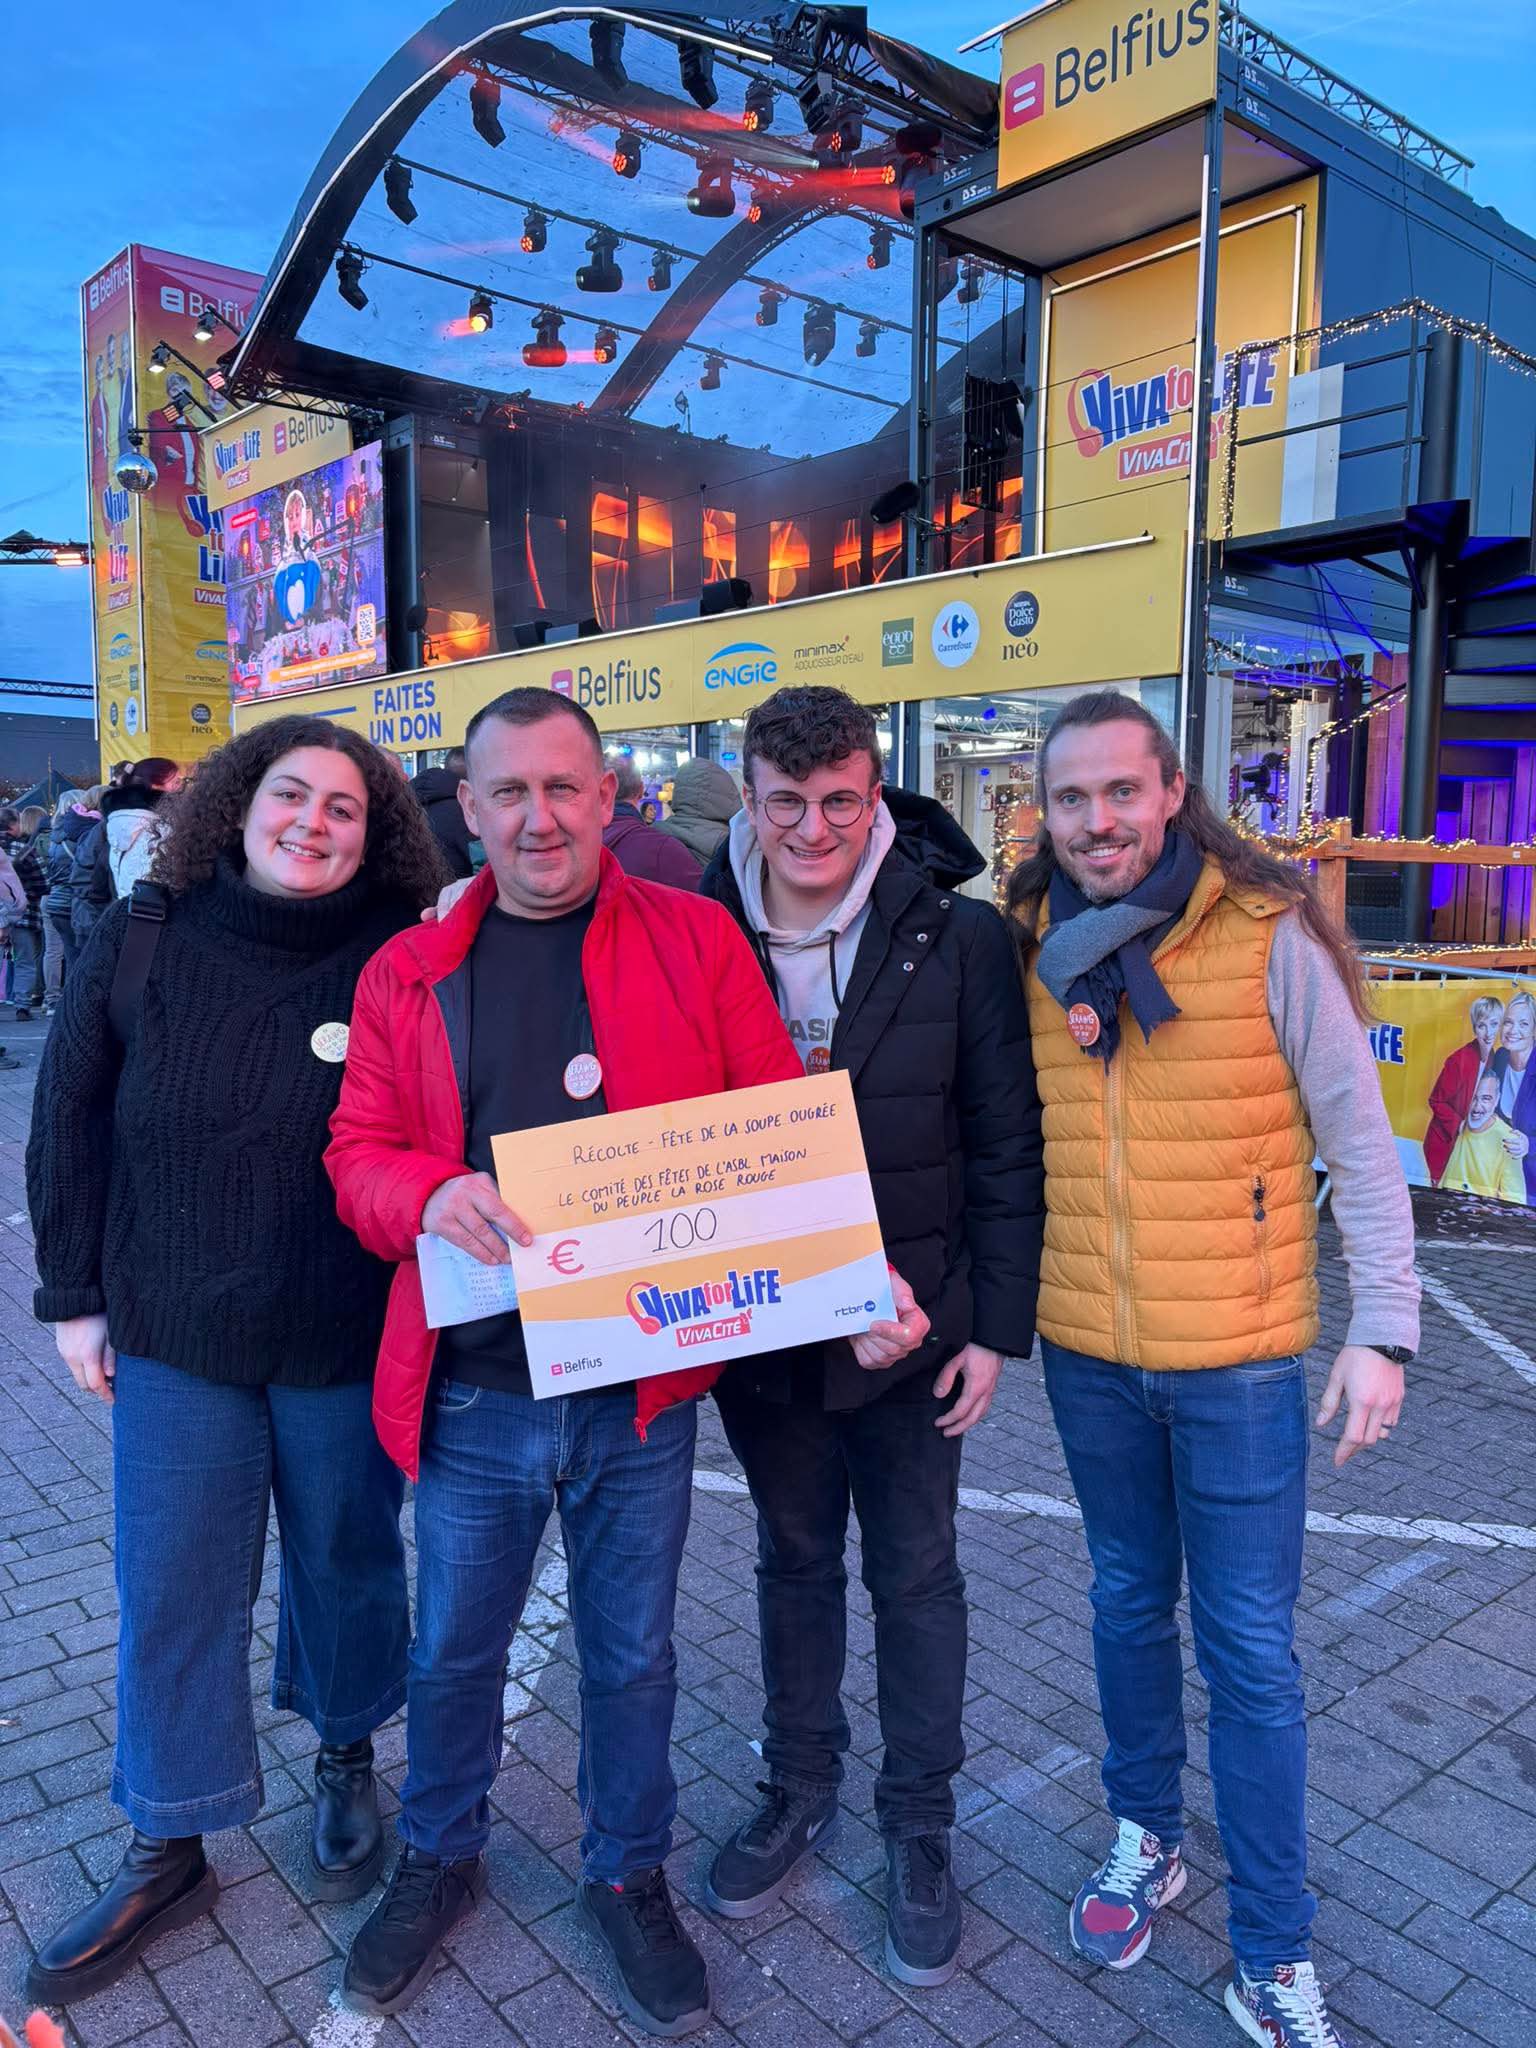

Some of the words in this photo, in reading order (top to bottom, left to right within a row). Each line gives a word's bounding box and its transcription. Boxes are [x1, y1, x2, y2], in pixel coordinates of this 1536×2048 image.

[1055, 0, 1210, 108] Belfius
[100, 263, 129, 303] Belfius
[189, 291, 250, 327] Belfiu
[1166, 366, 1193, 410] fo
[288, 408, 335, 448] Belfius
[1122, 438, 1191, 474] VIVACIT
[210, 528, 224, 552] fo
[1009, 606, 1034, 618] Dolce
[1009, 616, 1034, 627] Gusto
[794, 641, 845, 658] minimax
[937, 640, 972, 652] Carrefour
[374, 680, 436, 715] FAITES
[578, 659, 661, 707] Belfius
[370, 718, 394, 745] UN
[400, 711, 442, 742] DON
[1369, 1023, 1404, 1063] iFE
[573, 1142, 639, 1165] RÉCOLTE
[661, 1129, 693, 1148] FÊTE
[701, 1125, 716, 1141] DE
[724, 1122, 738, 1136] LA
[745, 1114, 781, 1134] SOUPE
[790, 1102, 837, 1123] OUGRÉE
[559, 1193, 574, 1207] LE
[634, 1174, 653, 1193] DES
[659, 1168, 689, 1186] FÊTES
[697, 1164, 711, 1179] DE
[716, 1157, 751, 1175] L'ASBL
[593, 1201, 608, 1214] DU
[616, 1190, 661, 1208] PEUPLE
[671, 1186, 686, 1198] LA
[695, 1178, 725, 1194] ROSE
[737, 1169, 776, 1186] ROUGE
[547, 1239, 584, 1275] €
[644, 1207, 717, 1253] 100
[703, 1281, 733, 1307] for
[678, 1320, 742, 1347] VIVACITÉ
[563, 1357, 603, 1374] Belfius
